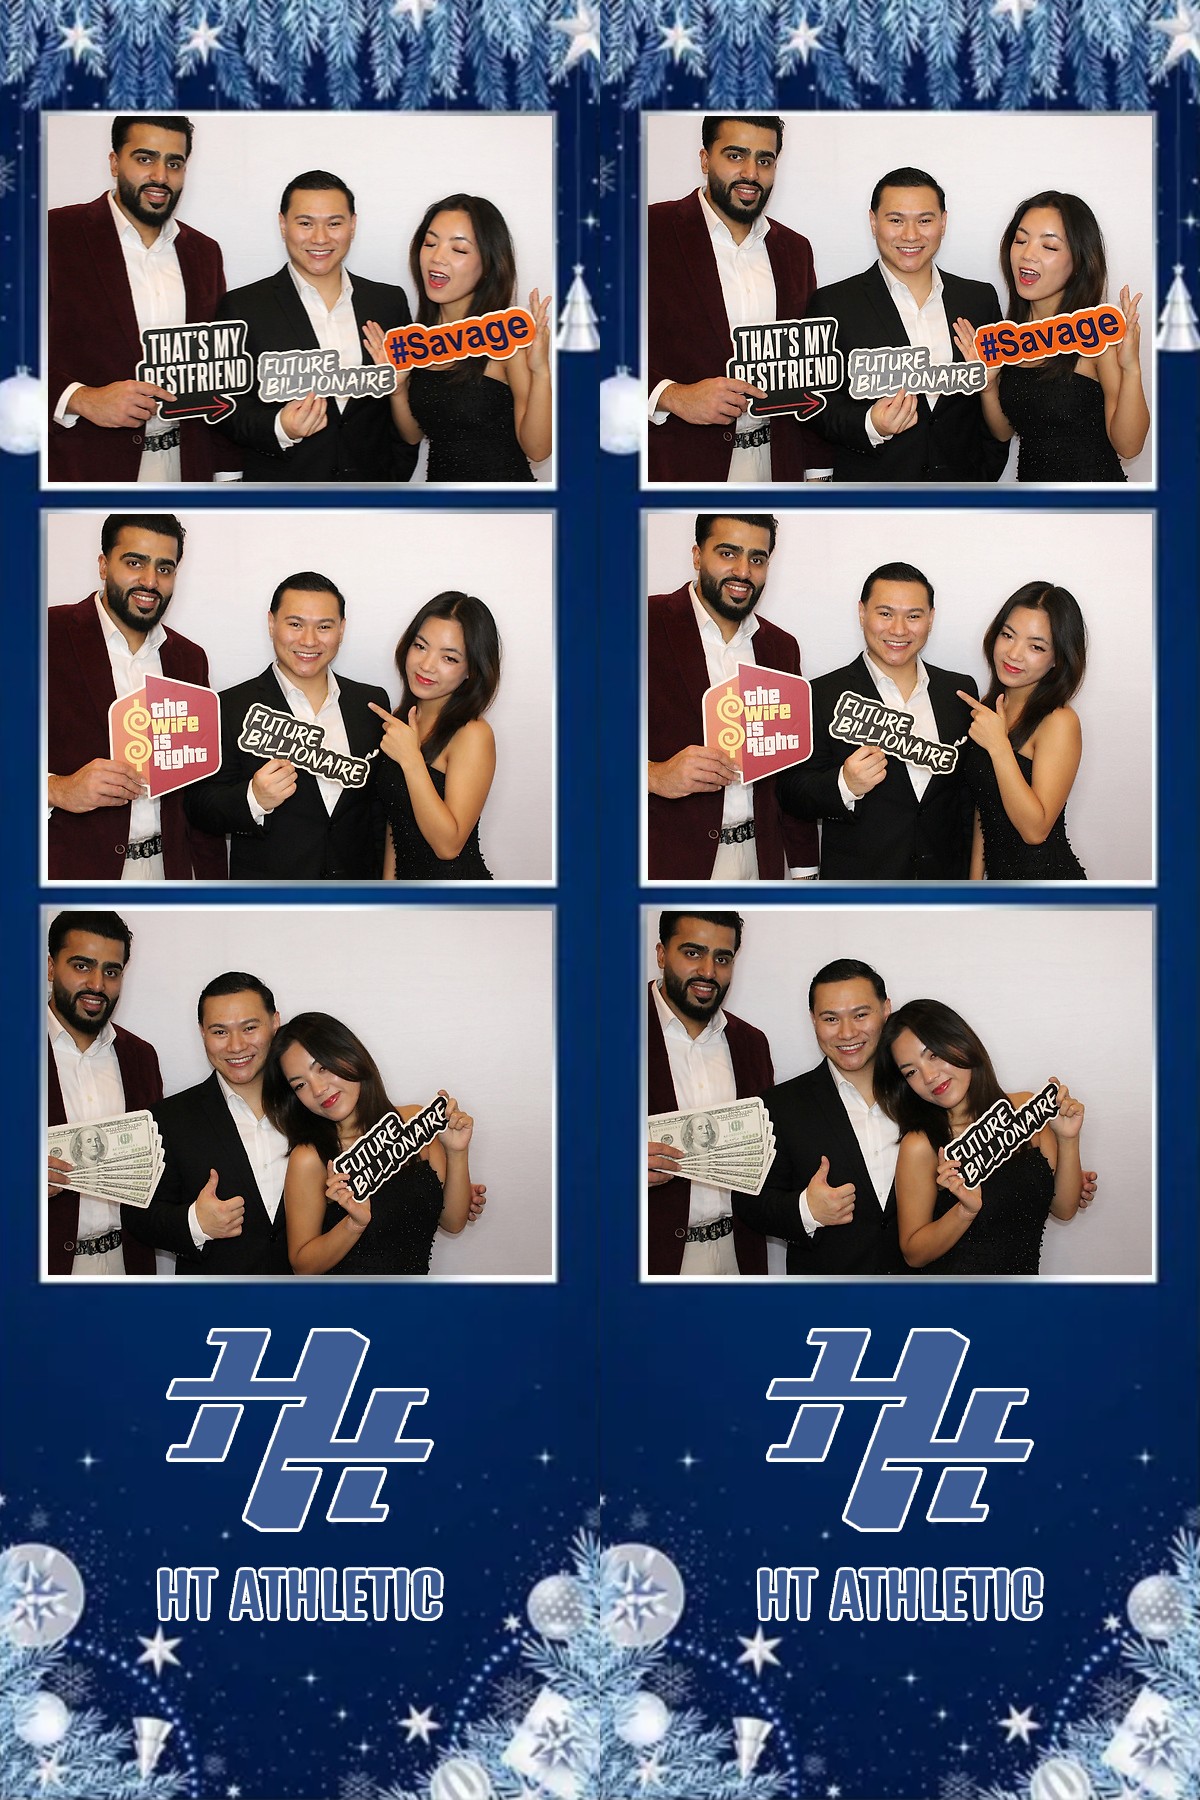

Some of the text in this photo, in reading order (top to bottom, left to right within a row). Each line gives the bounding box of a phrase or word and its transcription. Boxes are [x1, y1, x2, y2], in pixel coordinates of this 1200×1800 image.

[149, 328, 241, 364] THAT'S MY
[390, 316, 529, 364] #Savage
[739, 324, 832, 361] THAT'S MY
[980, 312, 1120, 361] #Savage
[144, 358, 247, 395] BESTFRIEND
[264, 353, 335, 376] FUTURE
[735, 355, 837, 392] BESTFRIEND
[854, 351, 925, 373] FUTURE
[855, 366, 982, 393] BILLIONAIRE
[265, 369, 391, 396] BILLIONAIRE
[151, 698, 188, 718] the
[744, 685, 780, 706] the
[249, 709, 323, 748] FUTURE
[745, 721, 764, 738] is
[840, 697, 912, 734] FUTURE
[153, 734, 171, 750] is
[154, 745, 207, 771] Right
[245, 728, 364, 783] BILLIONAIRE
[746, 732, 799, 757] Right
[836, 717, 953, 769] BILLIONAIRE
[340, 1119, 400, 1174] FUTURE
[353, 1101, 447, 1196] BILLIONAIRE
[951, 1106, 1012, 1161] FUTURE
[964, 1088, 1058, 1183] BILLIONAIRE
